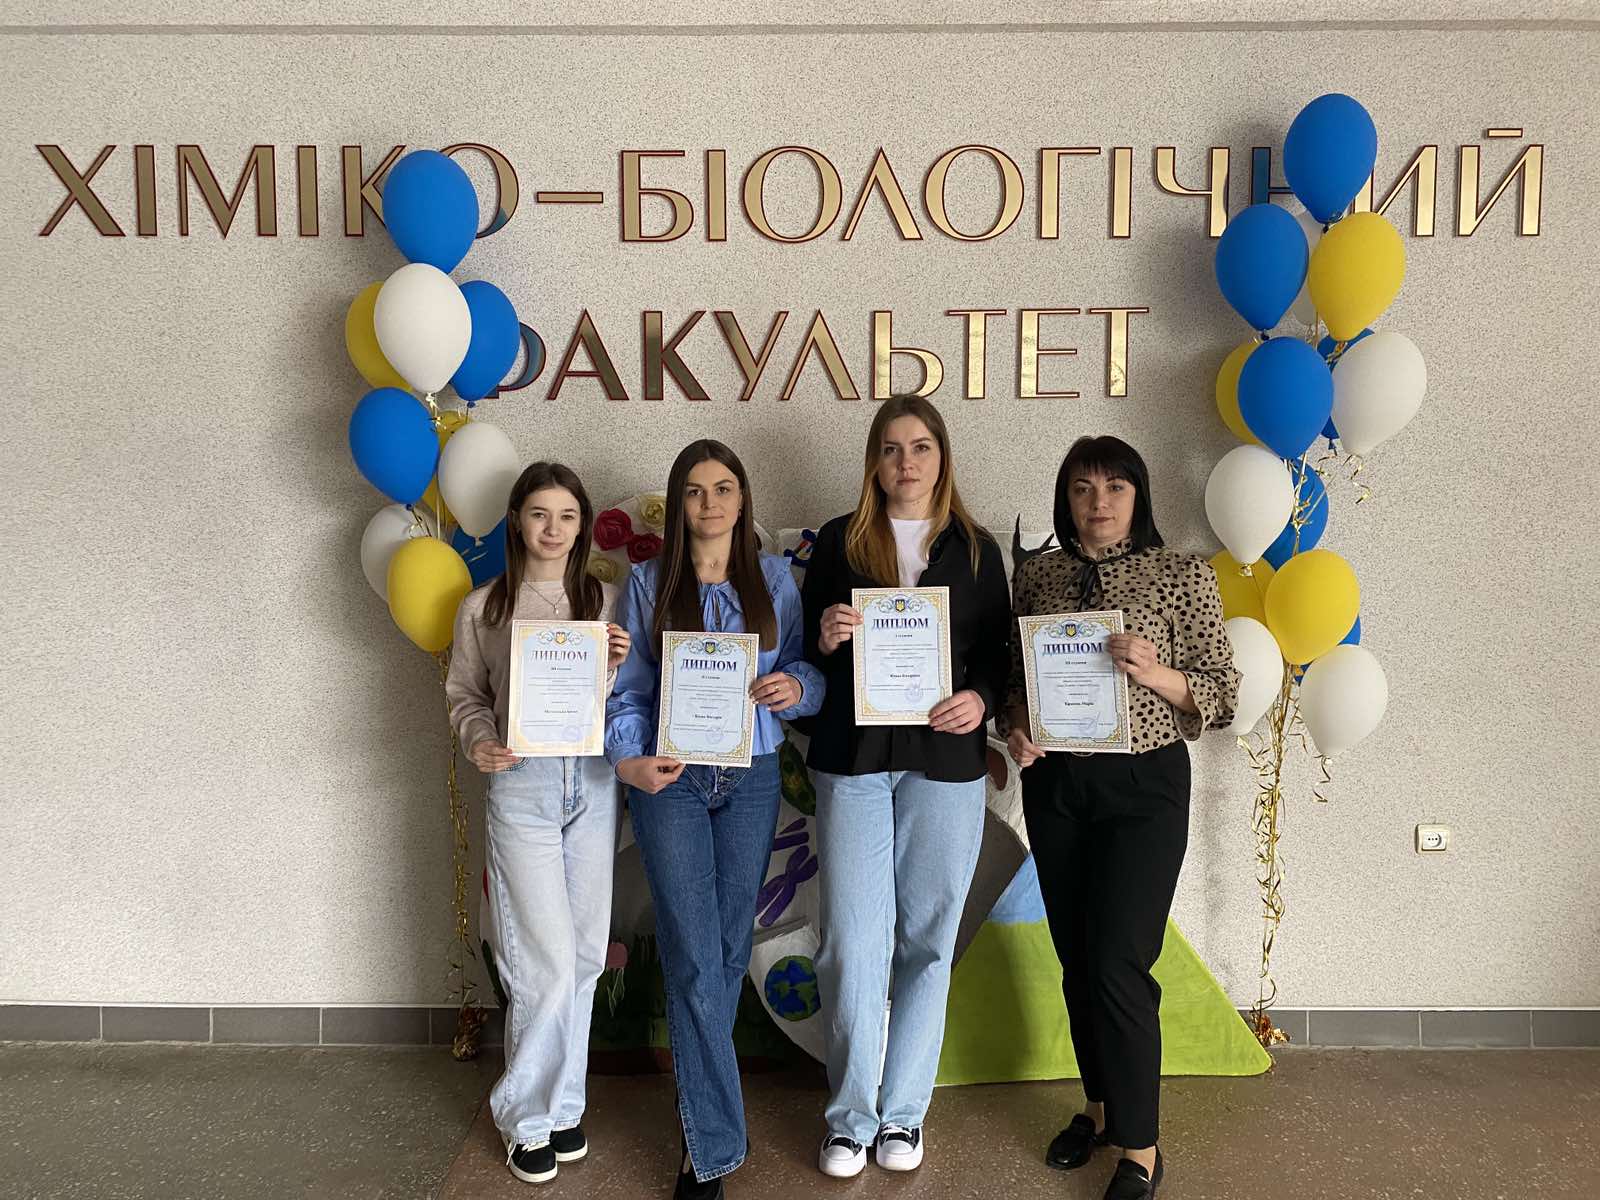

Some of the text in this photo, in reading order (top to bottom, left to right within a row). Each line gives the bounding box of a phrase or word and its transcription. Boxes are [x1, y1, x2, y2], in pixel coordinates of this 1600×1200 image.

[872, 618, 928, 629] ДИПЛОМ
[1042, 642, 1103, 656] ДИПЛОМ
[531, 650, 587, 662] ДИПЛОМ
[681, 659, 737, 672] ДИПЛОМ
